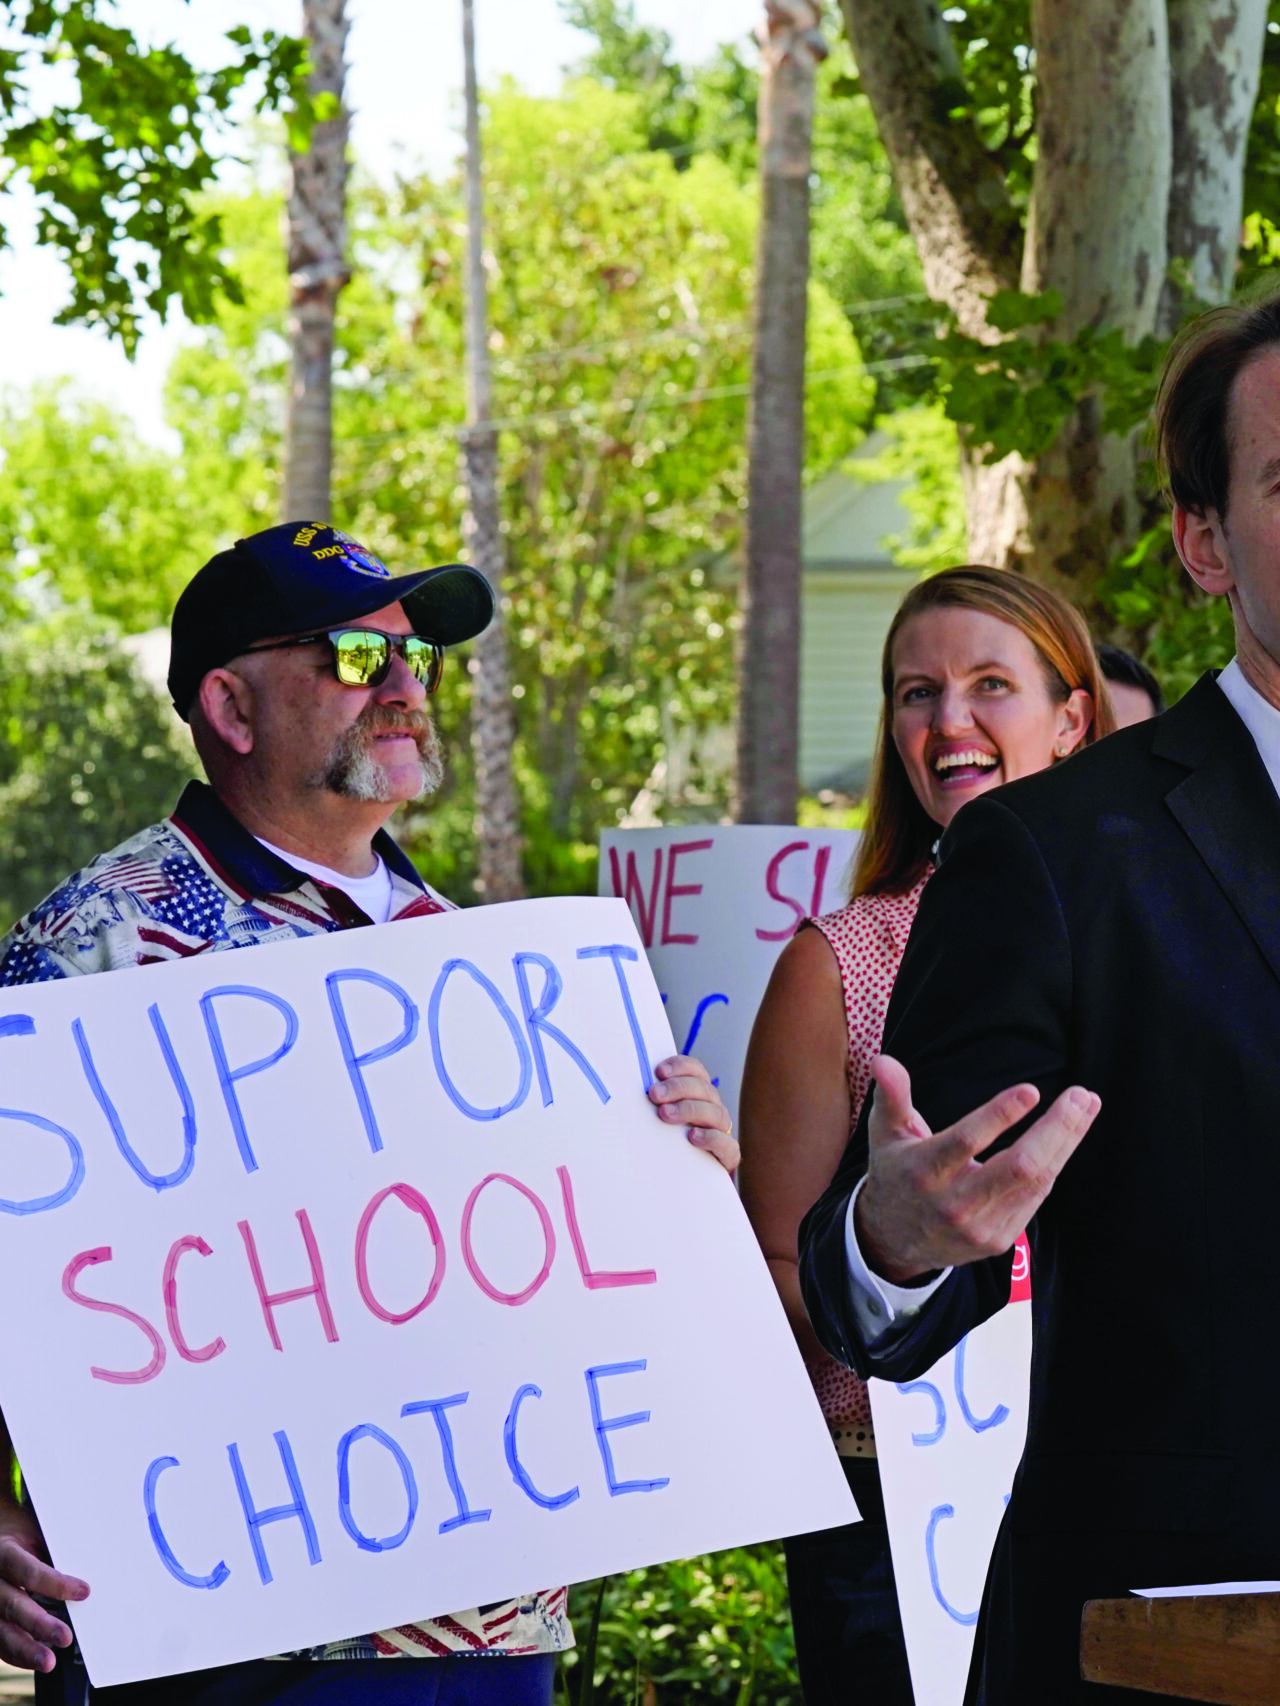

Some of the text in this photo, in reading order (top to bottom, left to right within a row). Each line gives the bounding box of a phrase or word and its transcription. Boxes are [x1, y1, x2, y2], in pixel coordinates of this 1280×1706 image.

[293, 527, 317, 547] USS
[608, 838, 714, 949] WE
[0, 944, 650, 1215] SUPPORT
[62, 1164, 657, 1385] SCHOOL
[143, 1359, 670, 1589] CHOICE
